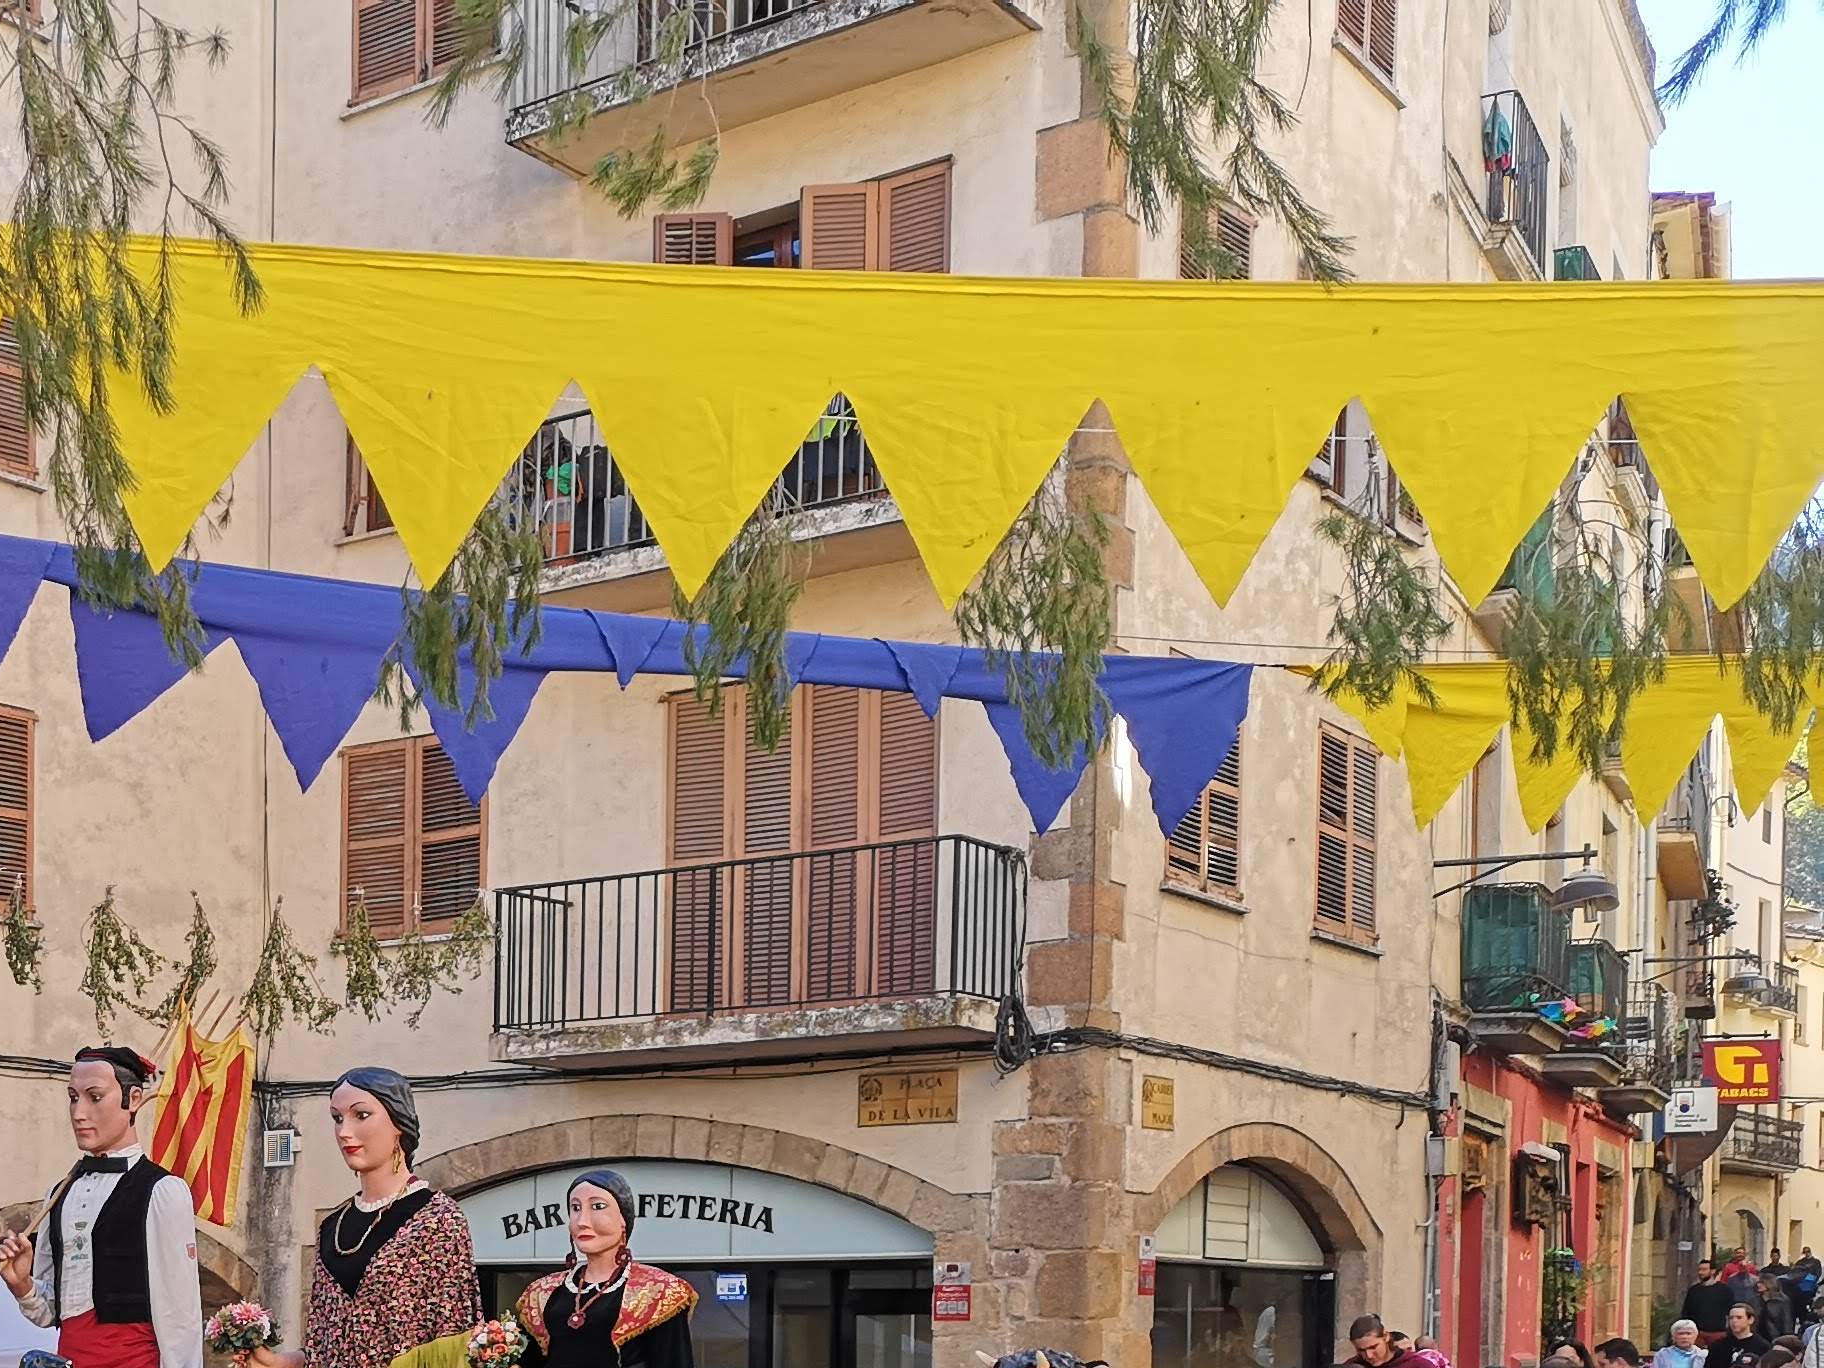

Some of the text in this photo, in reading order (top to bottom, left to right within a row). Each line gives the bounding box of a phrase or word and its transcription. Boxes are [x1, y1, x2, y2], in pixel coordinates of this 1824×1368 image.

[899, 1076, 943, 1090] PLAÇA
[1717, 1088, 1769, 1098] ABACS
[868, 1107, 954, 1122] DE LA VILA
[501, 1193, 775, 1240] BAR FETERIA
